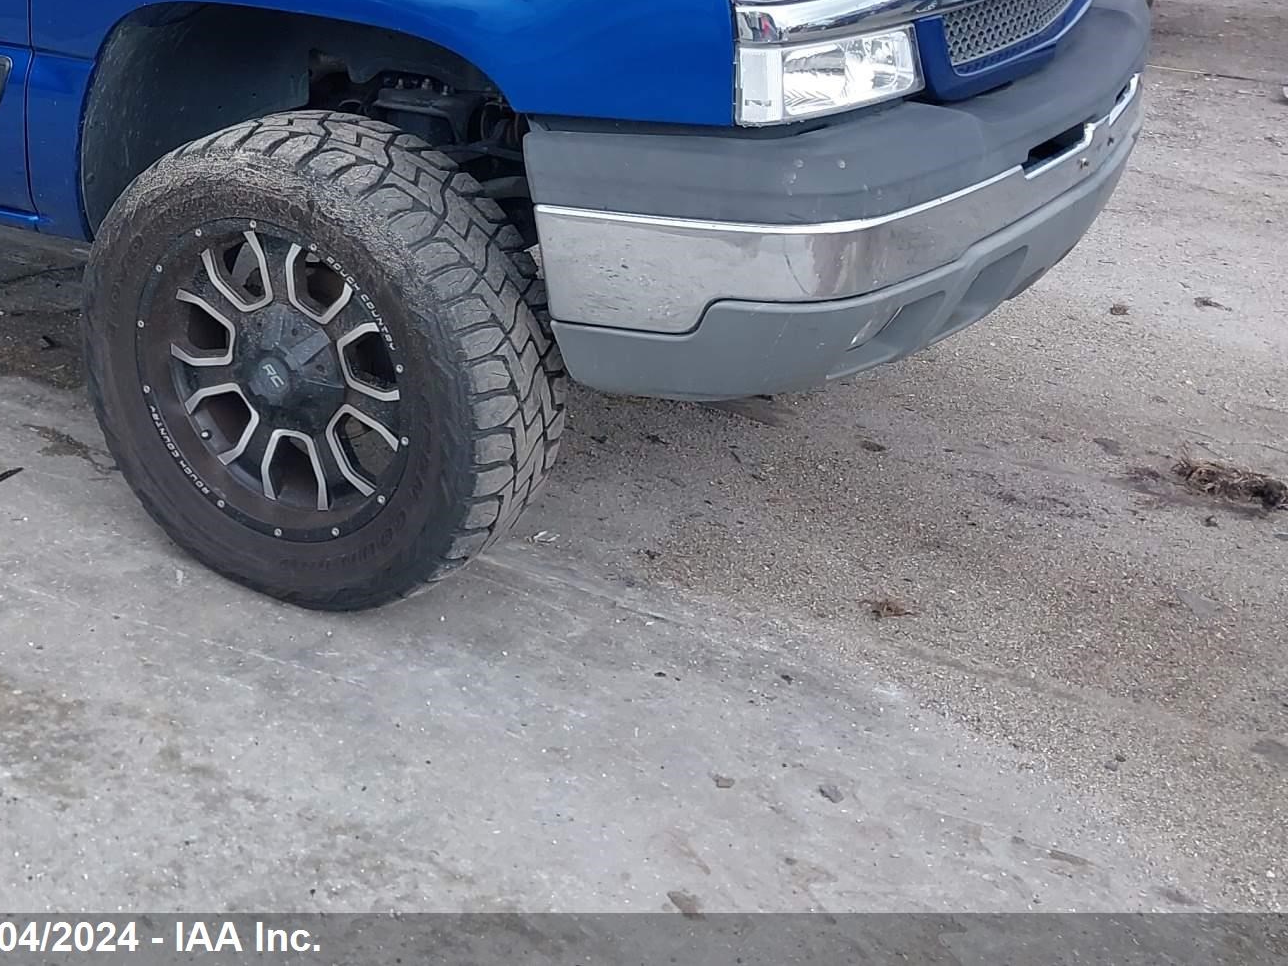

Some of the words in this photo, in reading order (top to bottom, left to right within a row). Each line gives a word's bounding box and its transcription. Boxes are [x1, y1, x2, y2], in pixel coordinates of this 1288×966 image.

[326, 256, 361, 291] ROUGH
[360, 293, 397, 351] COUNTRY
[262, 363, 285, 388] RC
[149, 405, 181, 458] COUNTRY
[179, 460, 211, 494] ROUGH
